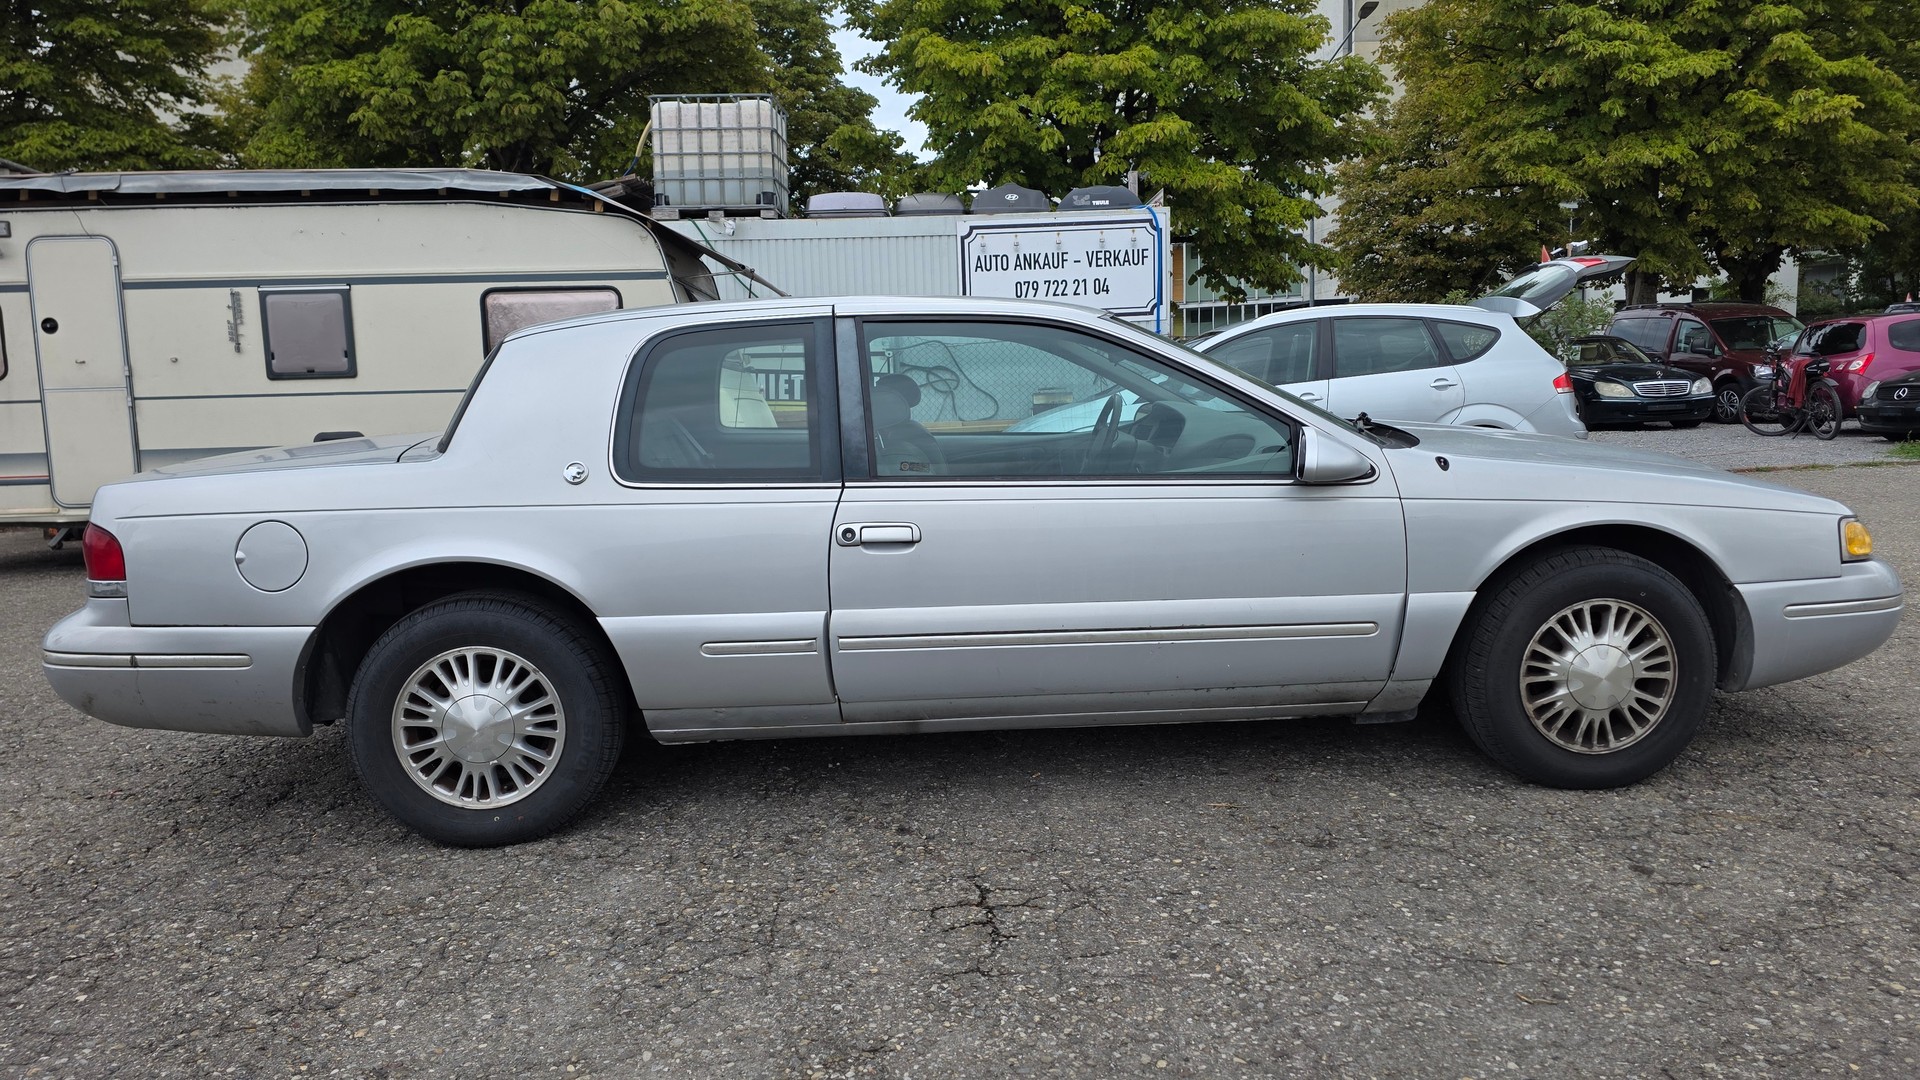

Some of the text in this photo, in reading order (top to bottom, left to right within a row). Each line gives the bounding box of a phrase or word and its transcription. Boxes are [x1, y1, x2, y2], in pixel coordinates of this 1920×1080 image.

[974, 253, 1009, 272] AUTO
[1013, 251, 1069, 271] ANKAUF
[1086, 248, 1149, 268] VERKAUF
[1015, 277, 1110, 299] 079 722 21 04
